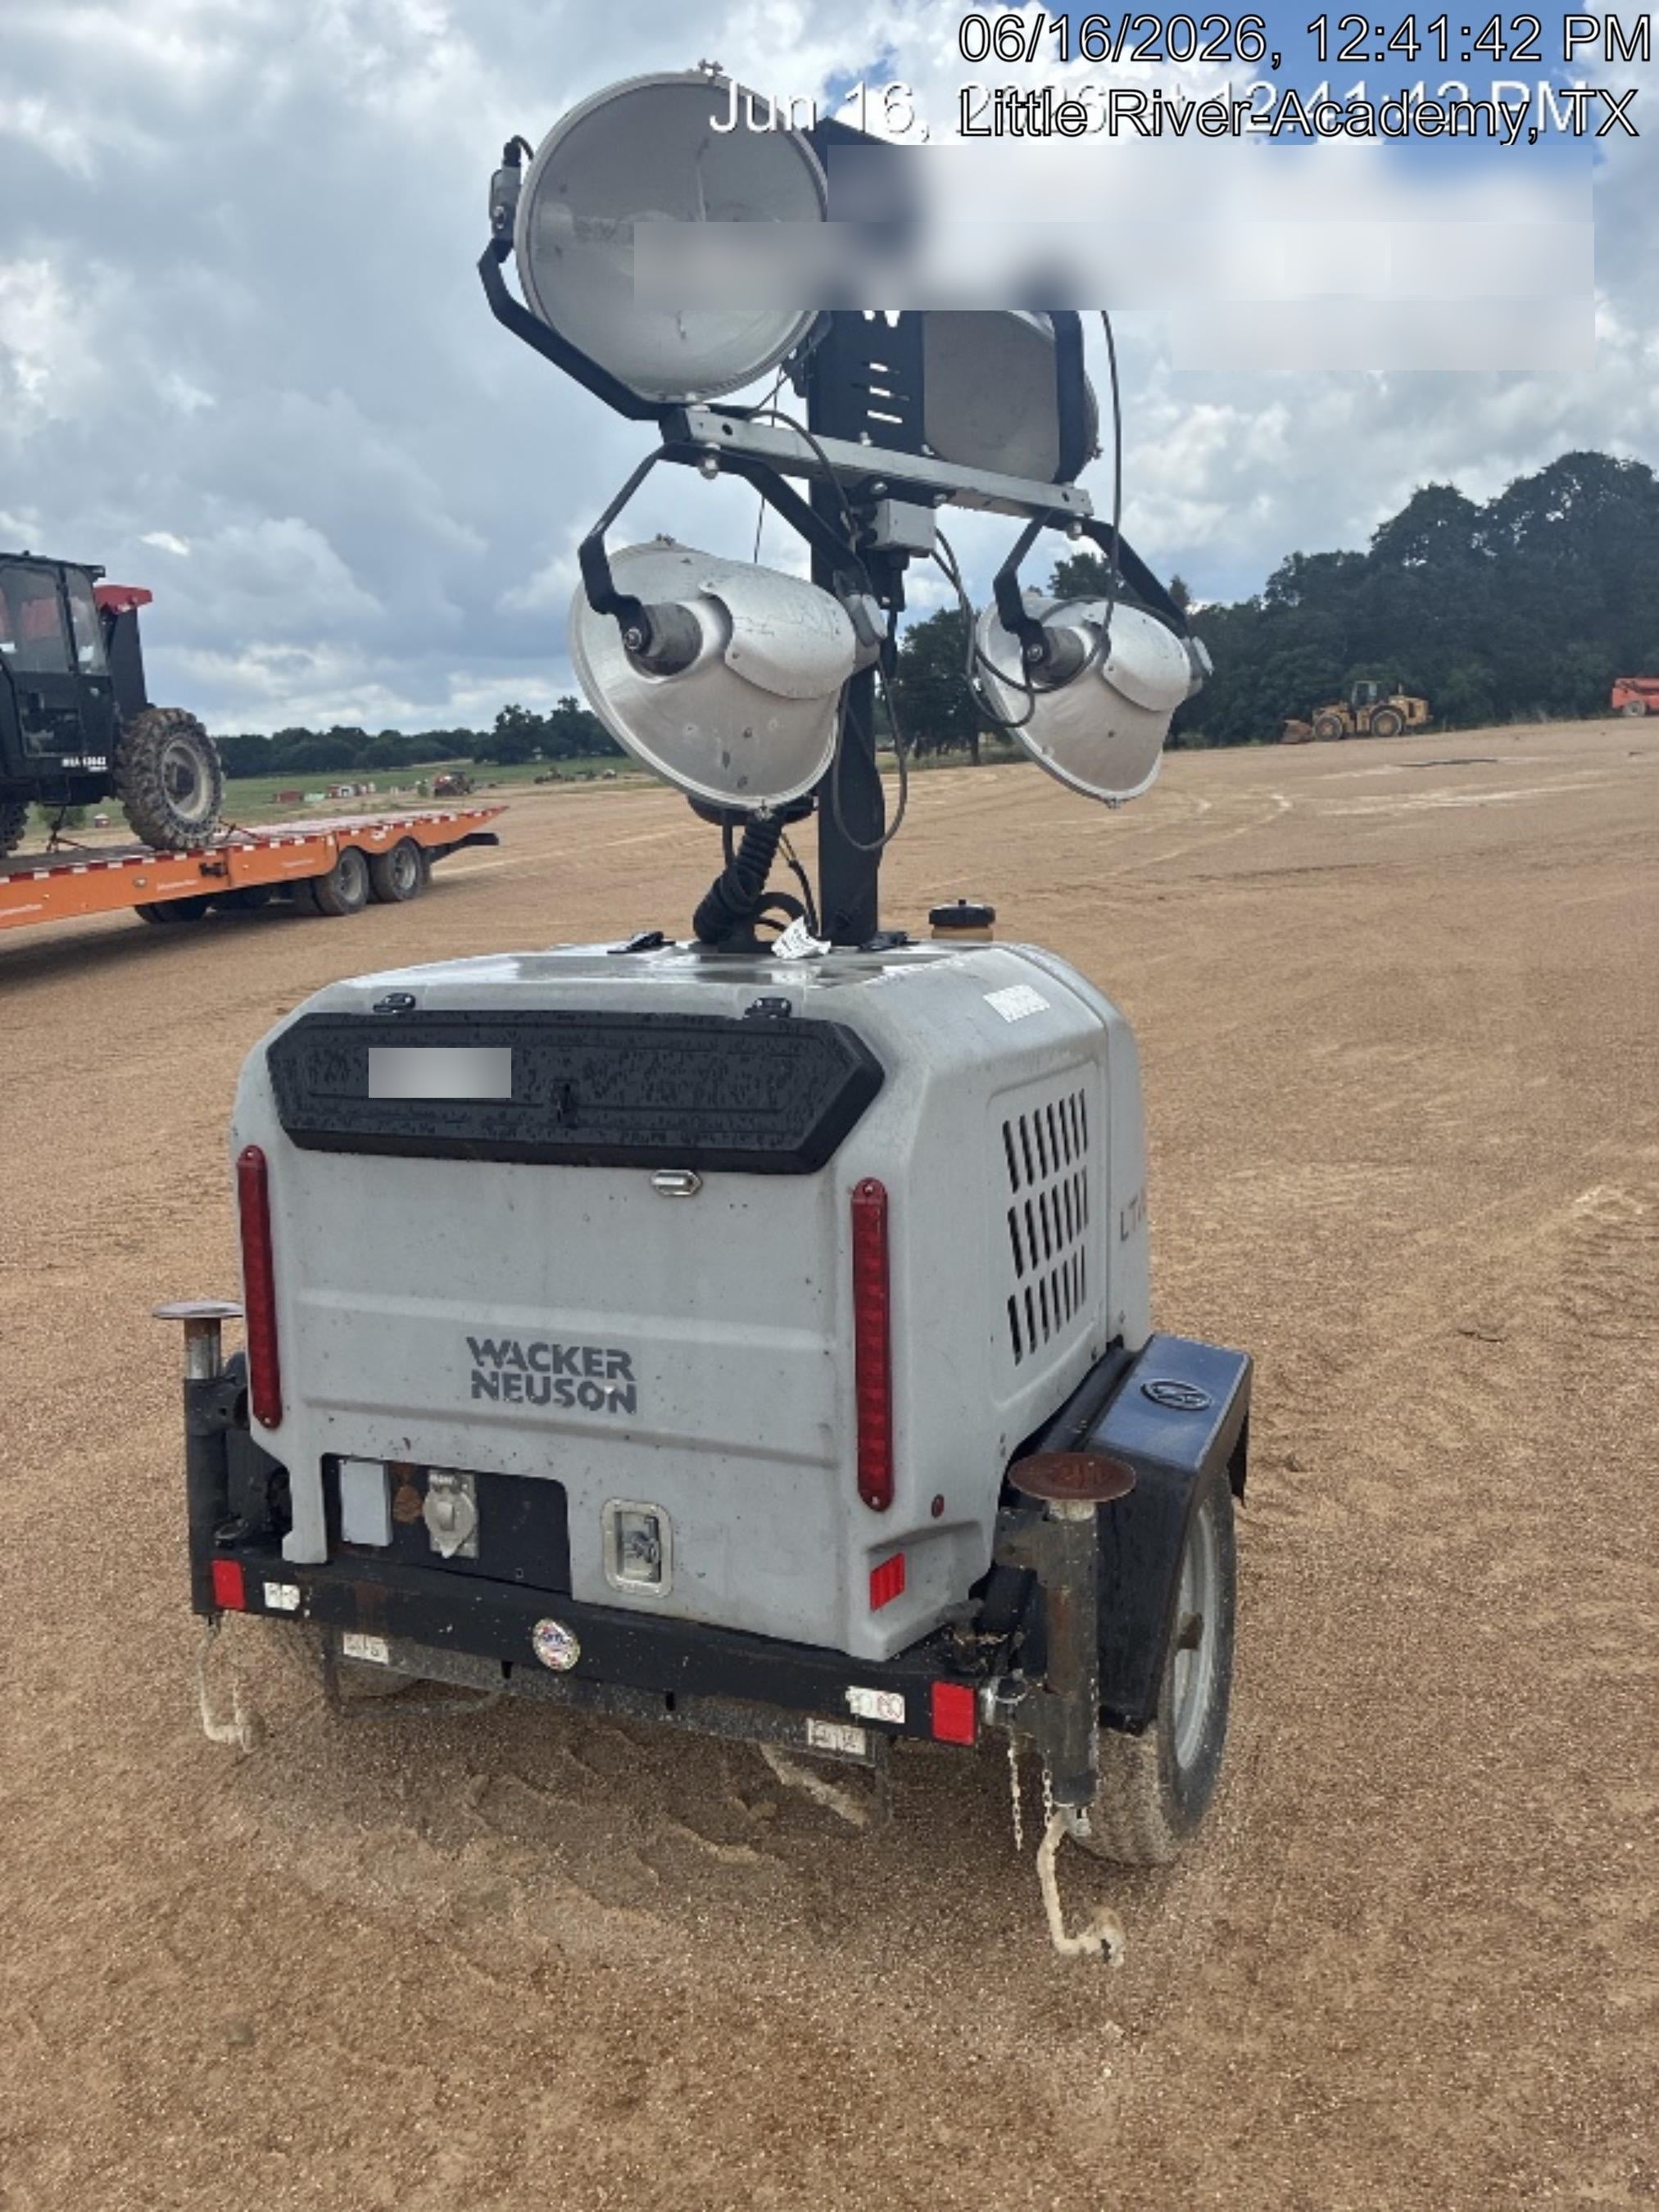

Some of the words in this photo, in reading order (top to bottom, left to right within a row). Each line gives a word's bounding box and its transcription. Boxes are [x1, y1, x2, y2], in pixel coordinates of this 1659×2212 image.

[1120, 1186, 1146, 1242] LT
[465, 1336, 637, 1381] WACKER
[471, 1369, 637, 1415] NEUSON
